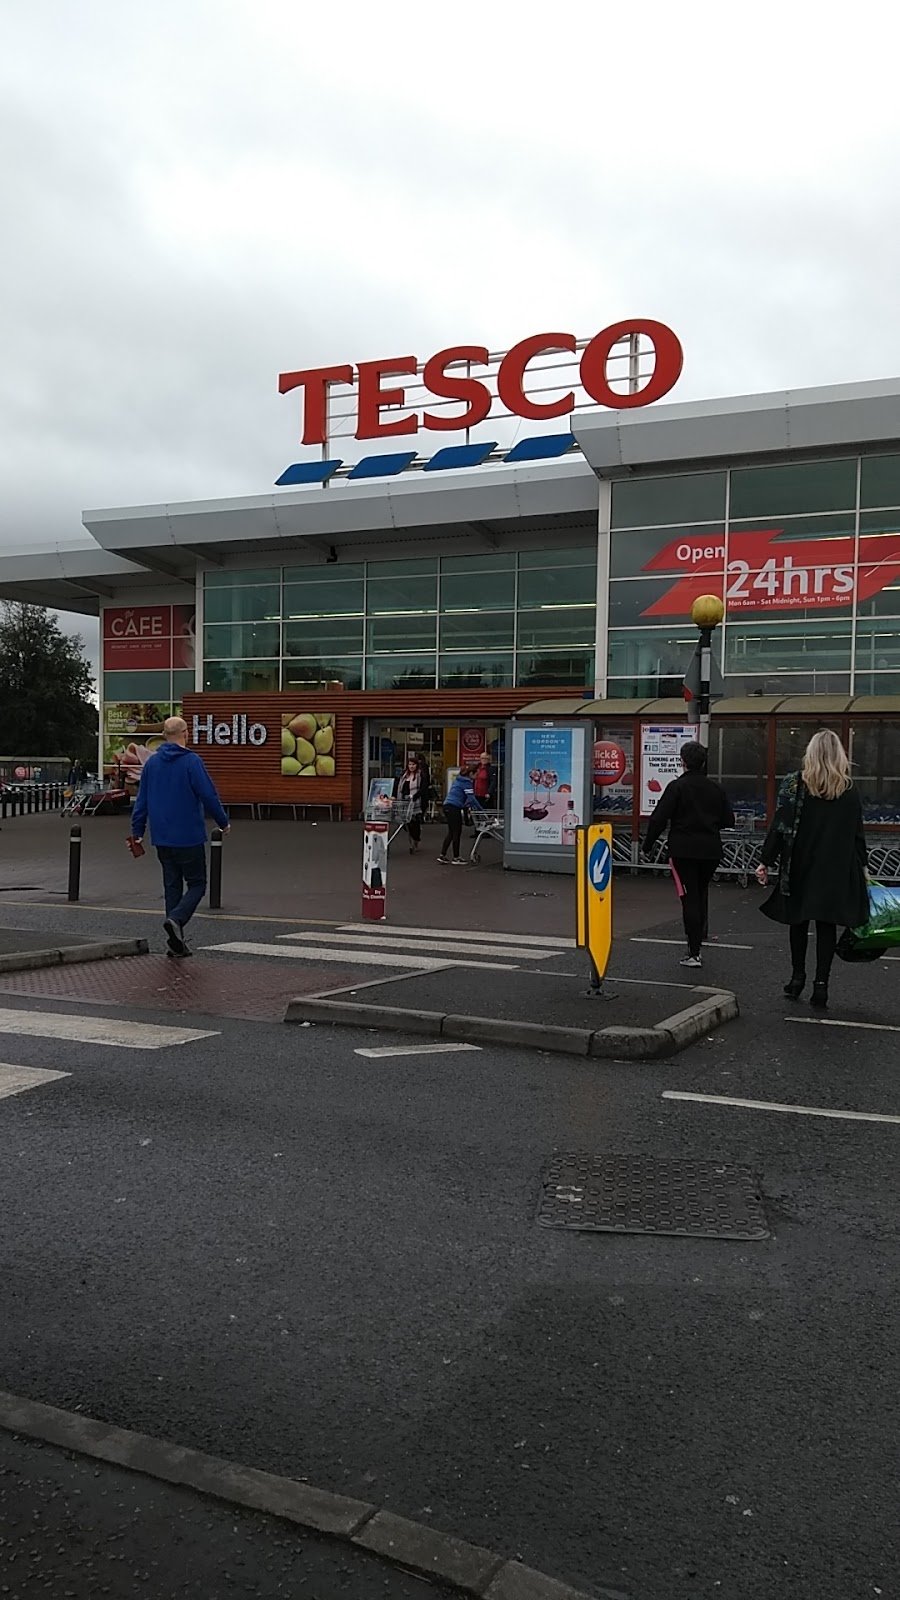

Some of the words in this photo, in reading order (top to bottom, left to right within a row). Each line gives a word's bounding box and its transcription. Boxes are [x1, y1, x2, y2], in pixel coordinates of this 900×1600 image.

[278, 318, 684, 446] TESCO
[676, 544, 725, 563] Open
[726, 556, 854, 599] 24hrs
[772, 597, 802, 605] Midnight,
[817, 596, 831, 604] 1pm
[111, 616, 163, 636] CAFE
[108, 710, 123, 718] Best
[192, 714, 267, 746] Hello
